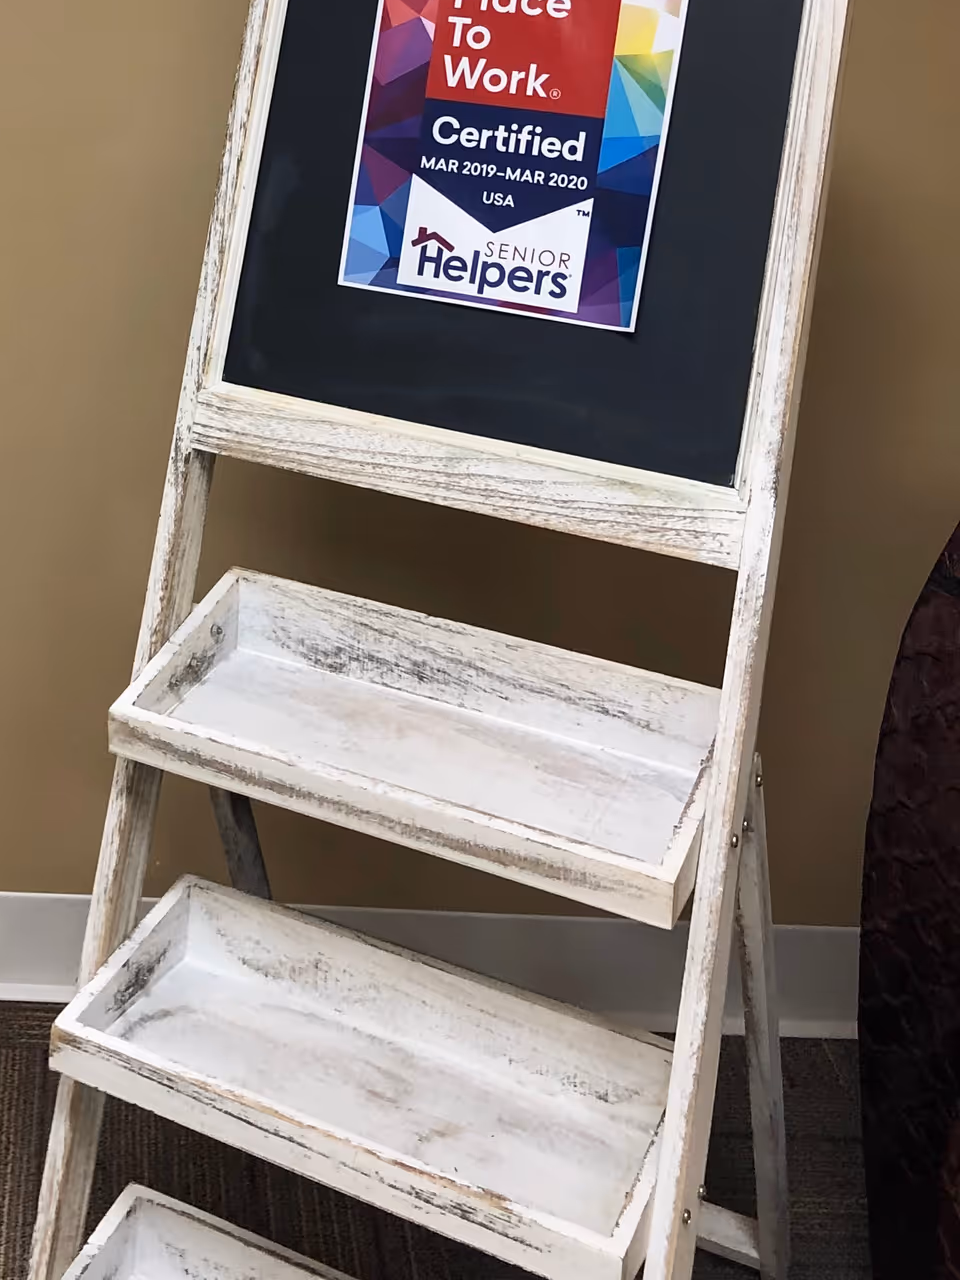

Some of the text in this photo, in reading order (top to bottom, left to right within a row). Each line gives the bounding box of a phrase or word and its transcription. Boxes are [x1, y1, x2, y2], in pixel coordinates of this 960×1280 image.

[447, 16, 491, 50] To
[431, 115, 587, 162] Certified
[420, 155, 459, 173] MAR
[548, 173, 588, 190] 2020
[482, 191, 515, 207] USA
[417, 244, 568, 299] Helpers
[484, 241, 571, 269] SENIOR
